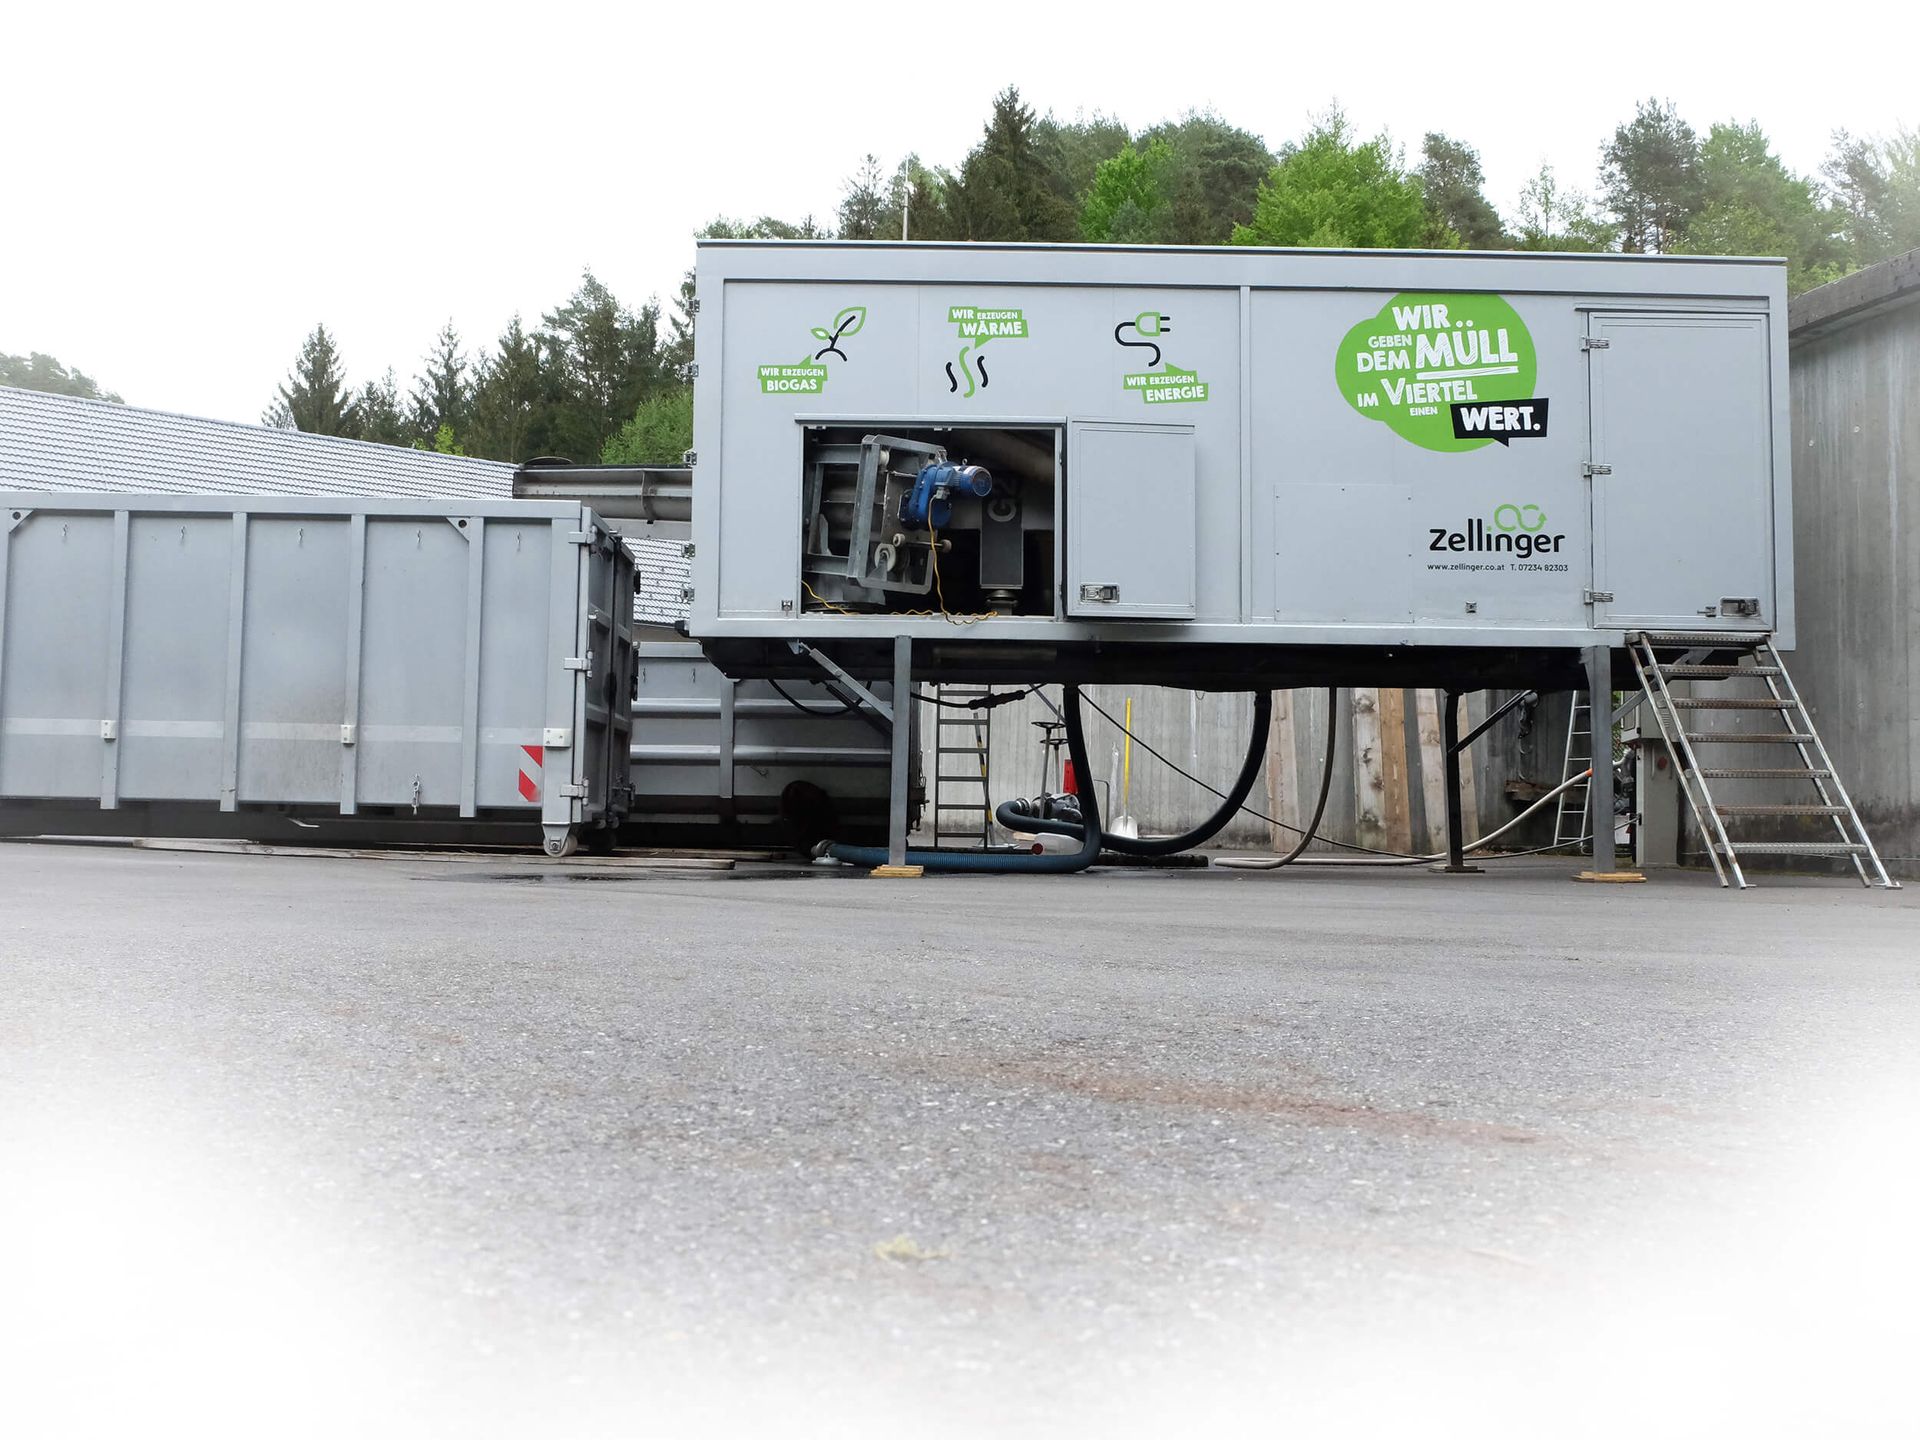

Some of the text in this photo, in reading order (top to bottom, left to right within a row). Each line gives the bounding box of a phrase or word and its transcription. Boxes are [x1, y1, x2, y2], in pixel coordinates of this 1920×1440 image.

[952, 308, 1018, 320] WIR ERZEUGEN
[1392, 304, 1451, 331] WIR
[962, 320, 1023, 336] WÄRME
[1356, 320, 1519, 373] DEM MÜLL
[1368, 334, 1412, 348] GEBEN
[760, 367, 824, 377] WIR ERZEUGEN
[766, 378, 818, 391] BIOGAS
[1126, 375, 1195, 386] WIR ERZEUGEN
[1145, 385, 1205, 402] ENERGIE
[1357, 378, 1478, 407] IM VIERTEL
[1410, 406, 1541, 431] EINEN WERT.
[1427, 563, 1569, 572] www.zellinger.co.at T. 07234 82303
